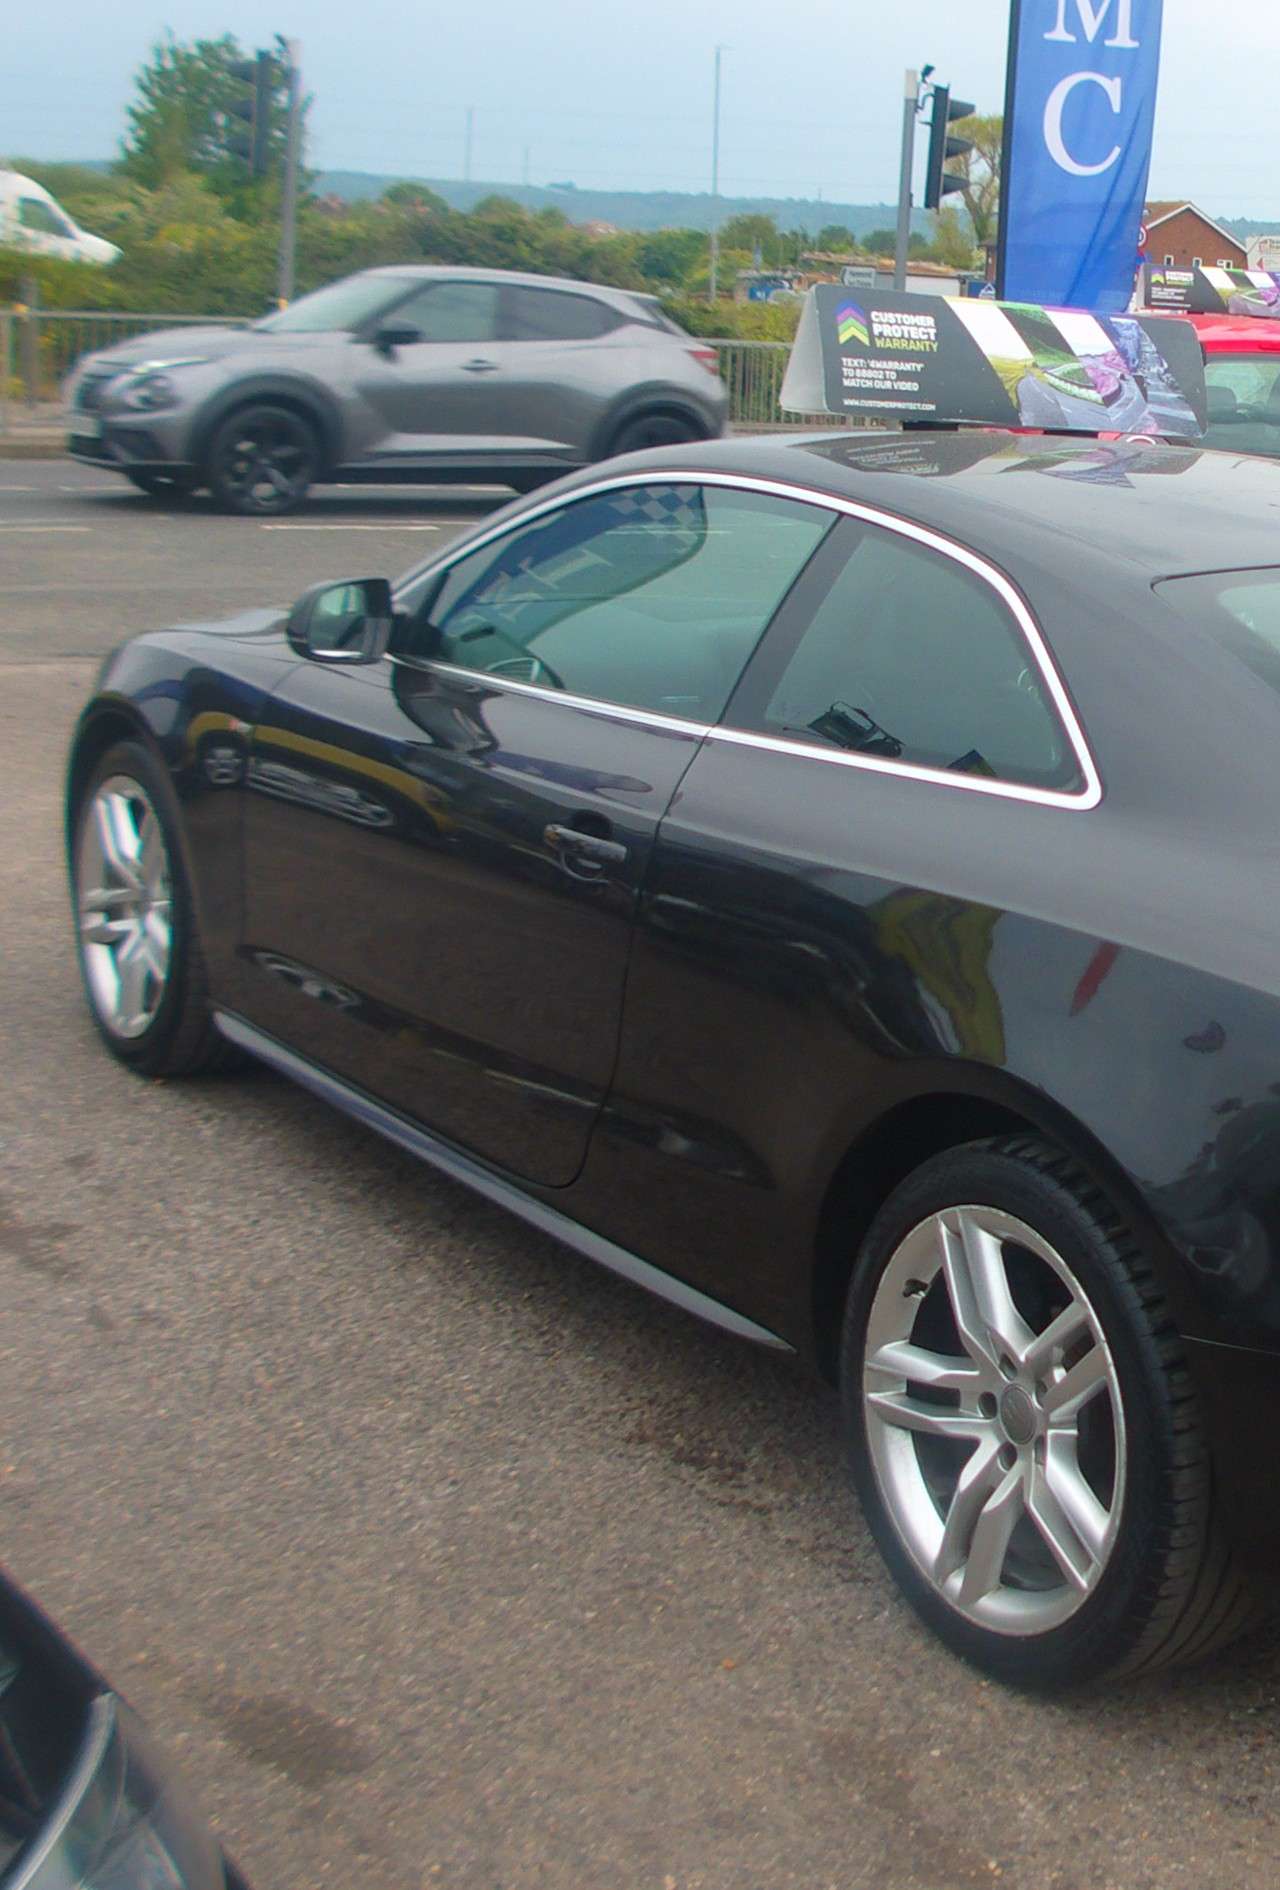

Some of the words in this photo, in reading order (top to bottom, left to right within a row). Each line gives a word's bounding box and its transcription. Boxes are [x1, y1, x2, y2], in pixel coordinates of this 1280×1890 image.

[871, 311, 935, 327] CUSTOMER
[872, 323, 937, 340] PROTECT
[874, 337, 939, 352] WARRANTY
[841, 357, 867, 368] TEXT:
[842, 368, 854, 377] TO
[885, 371, 897, 380] TO
[842, 378, 873, 389] WATCH
[874, 380, 892, 390] OUR
[892, 381, 919, 391] VIDEO
